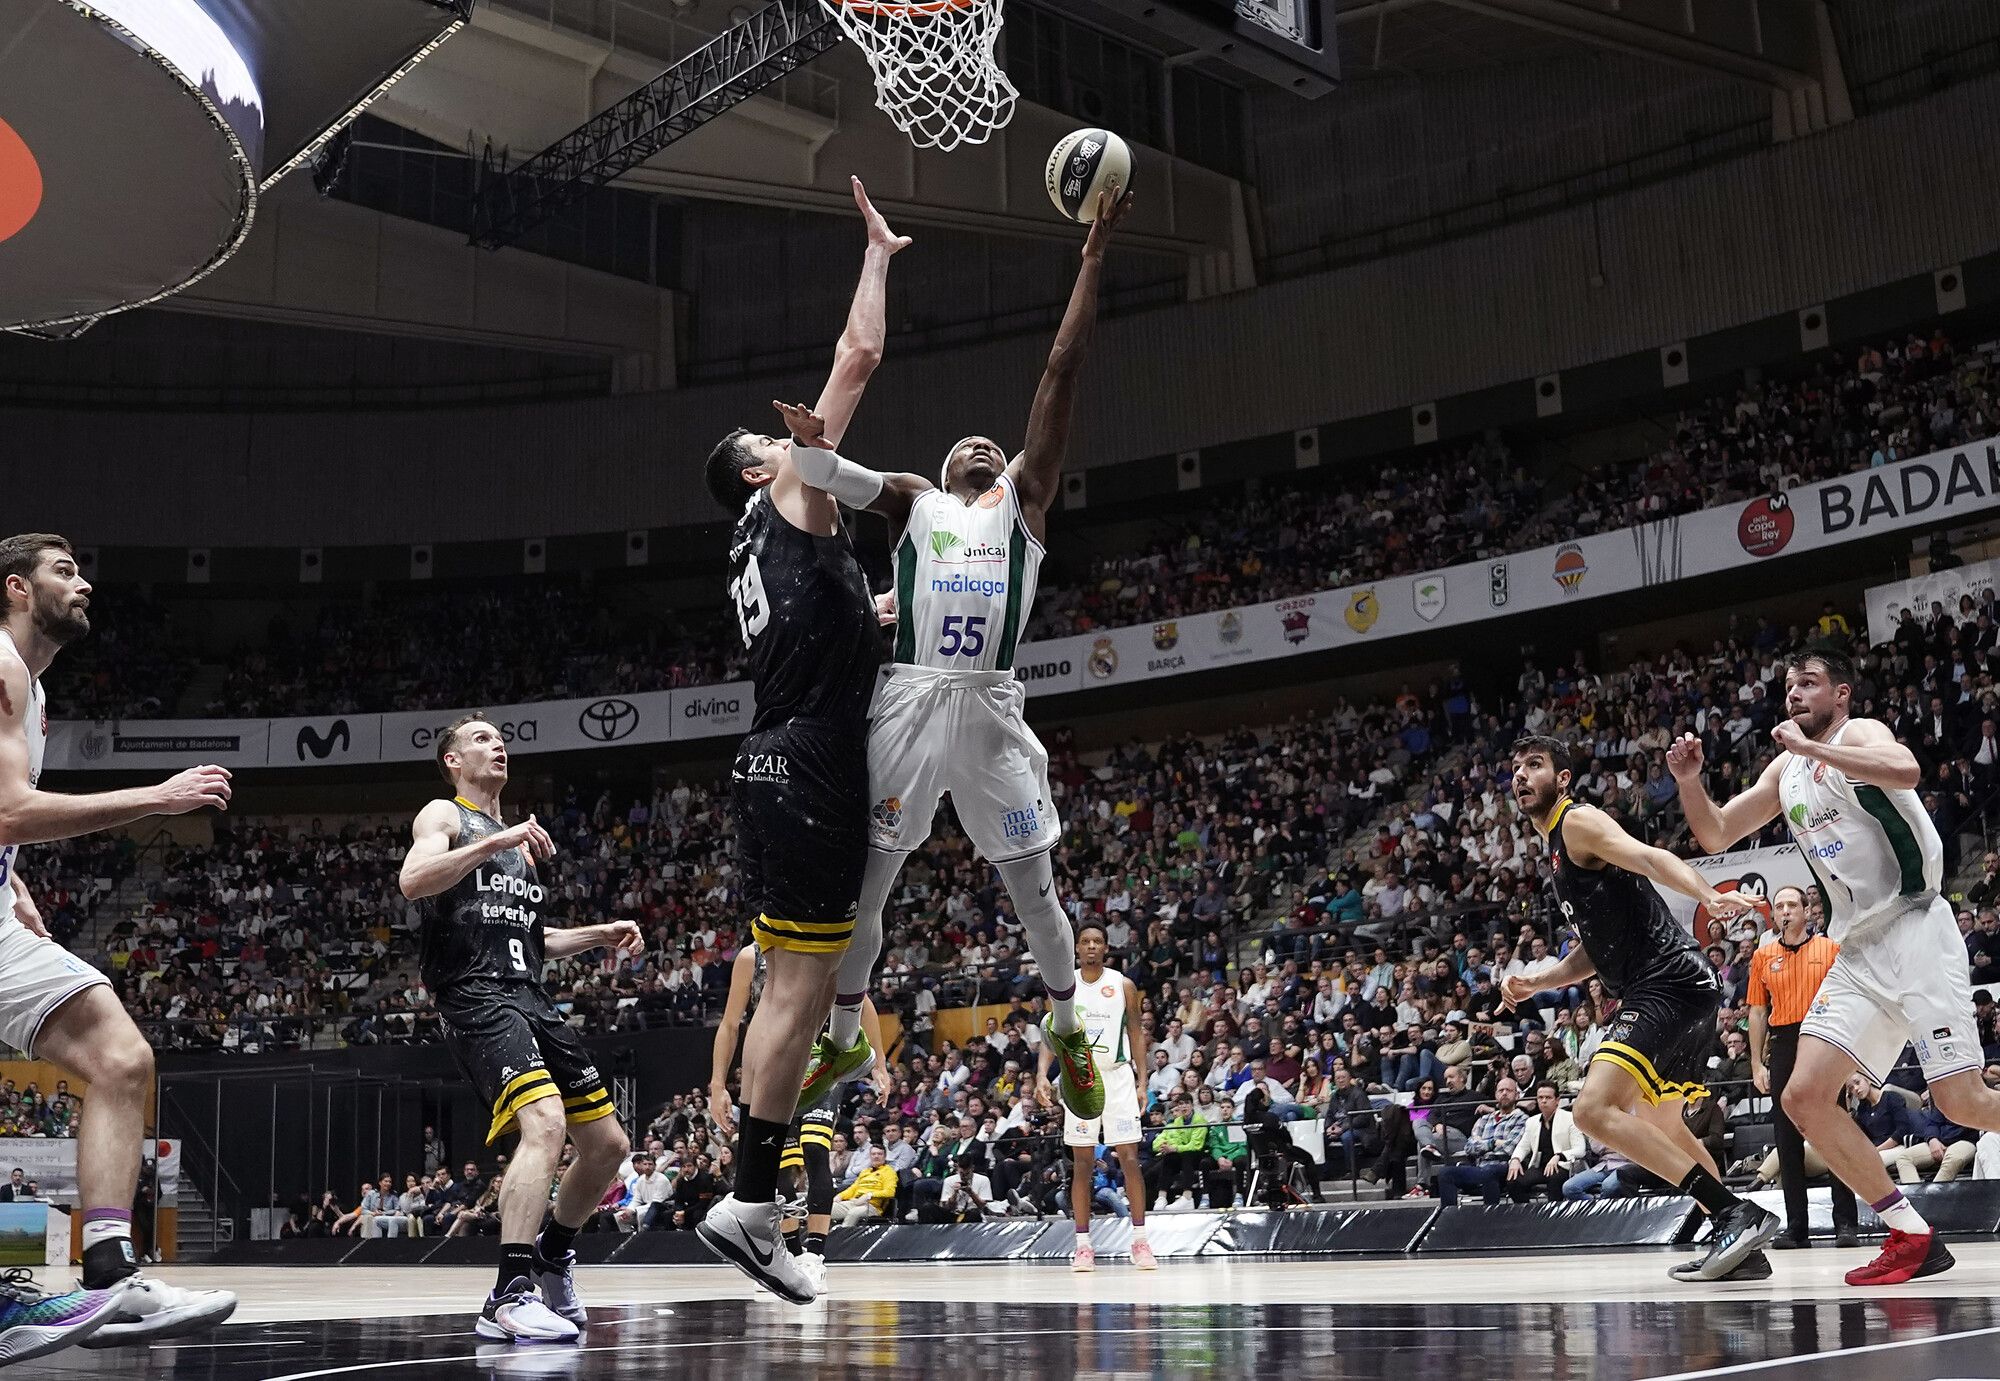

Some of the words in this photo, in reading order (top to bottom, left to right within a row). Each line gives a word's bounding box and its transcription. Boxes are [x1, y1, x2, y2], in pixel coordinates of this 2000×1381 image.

[1747, 520, 1776, 534] Copa
[1761, 529, 1780, 541] Rey
[730, 553, 770, 650] 19
[938, 615, 986, 658] 55
[1015, 660, 1071, 681] ONDO
[685, 698, 740, 718] divina
[120, 740, 174, 749] Ajuntament
[176, 740, 187, 748] de
[189, 739, 232, 748] Badalona
[775, 776, 790, 785] Car
[1003, 819, 1038, 838] laga
[475, 868, 543, 903] Lenovo
[508, 938, 527, 971] 9
